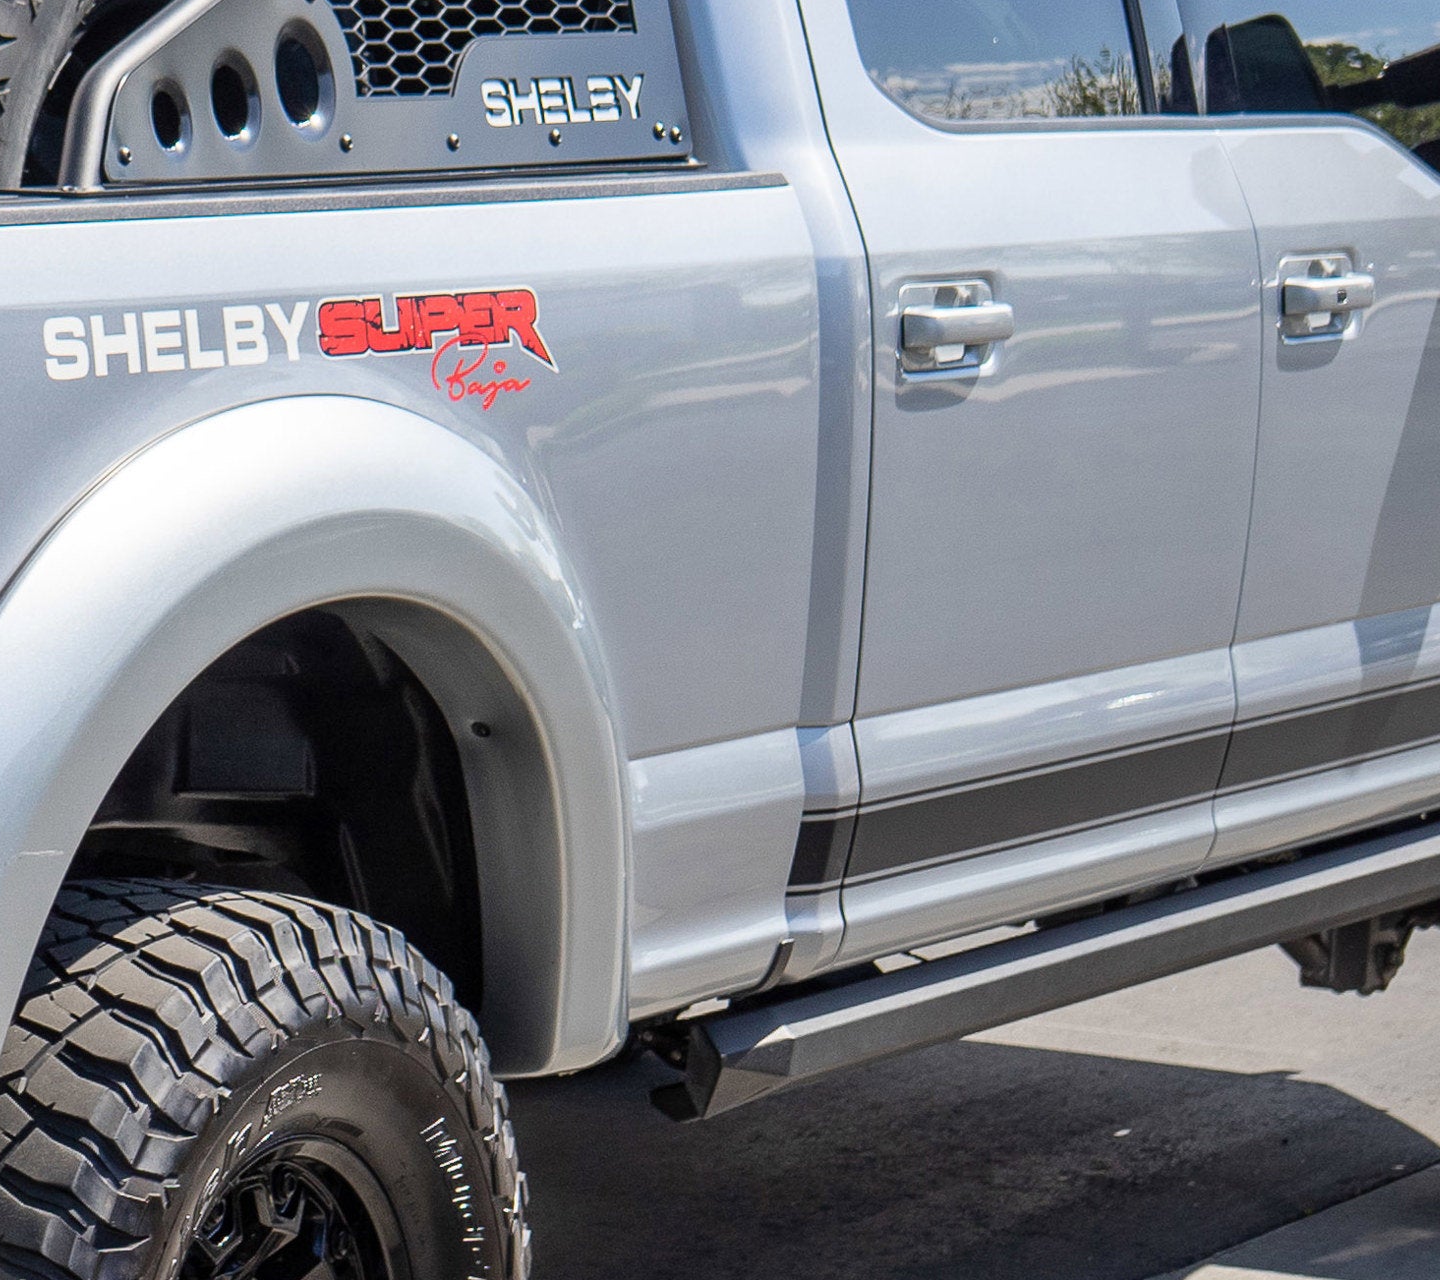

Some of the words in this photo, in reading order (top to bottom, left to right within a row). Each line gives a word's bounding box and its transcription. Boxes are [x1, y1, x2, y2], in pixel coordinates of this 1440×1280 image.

[481, 73, 644, 128] SHELBY
[42, 300, 310, 381] SHELBY
[316, 286, 559, 373] SUPER
[431, 334, 530, 411] Baja
